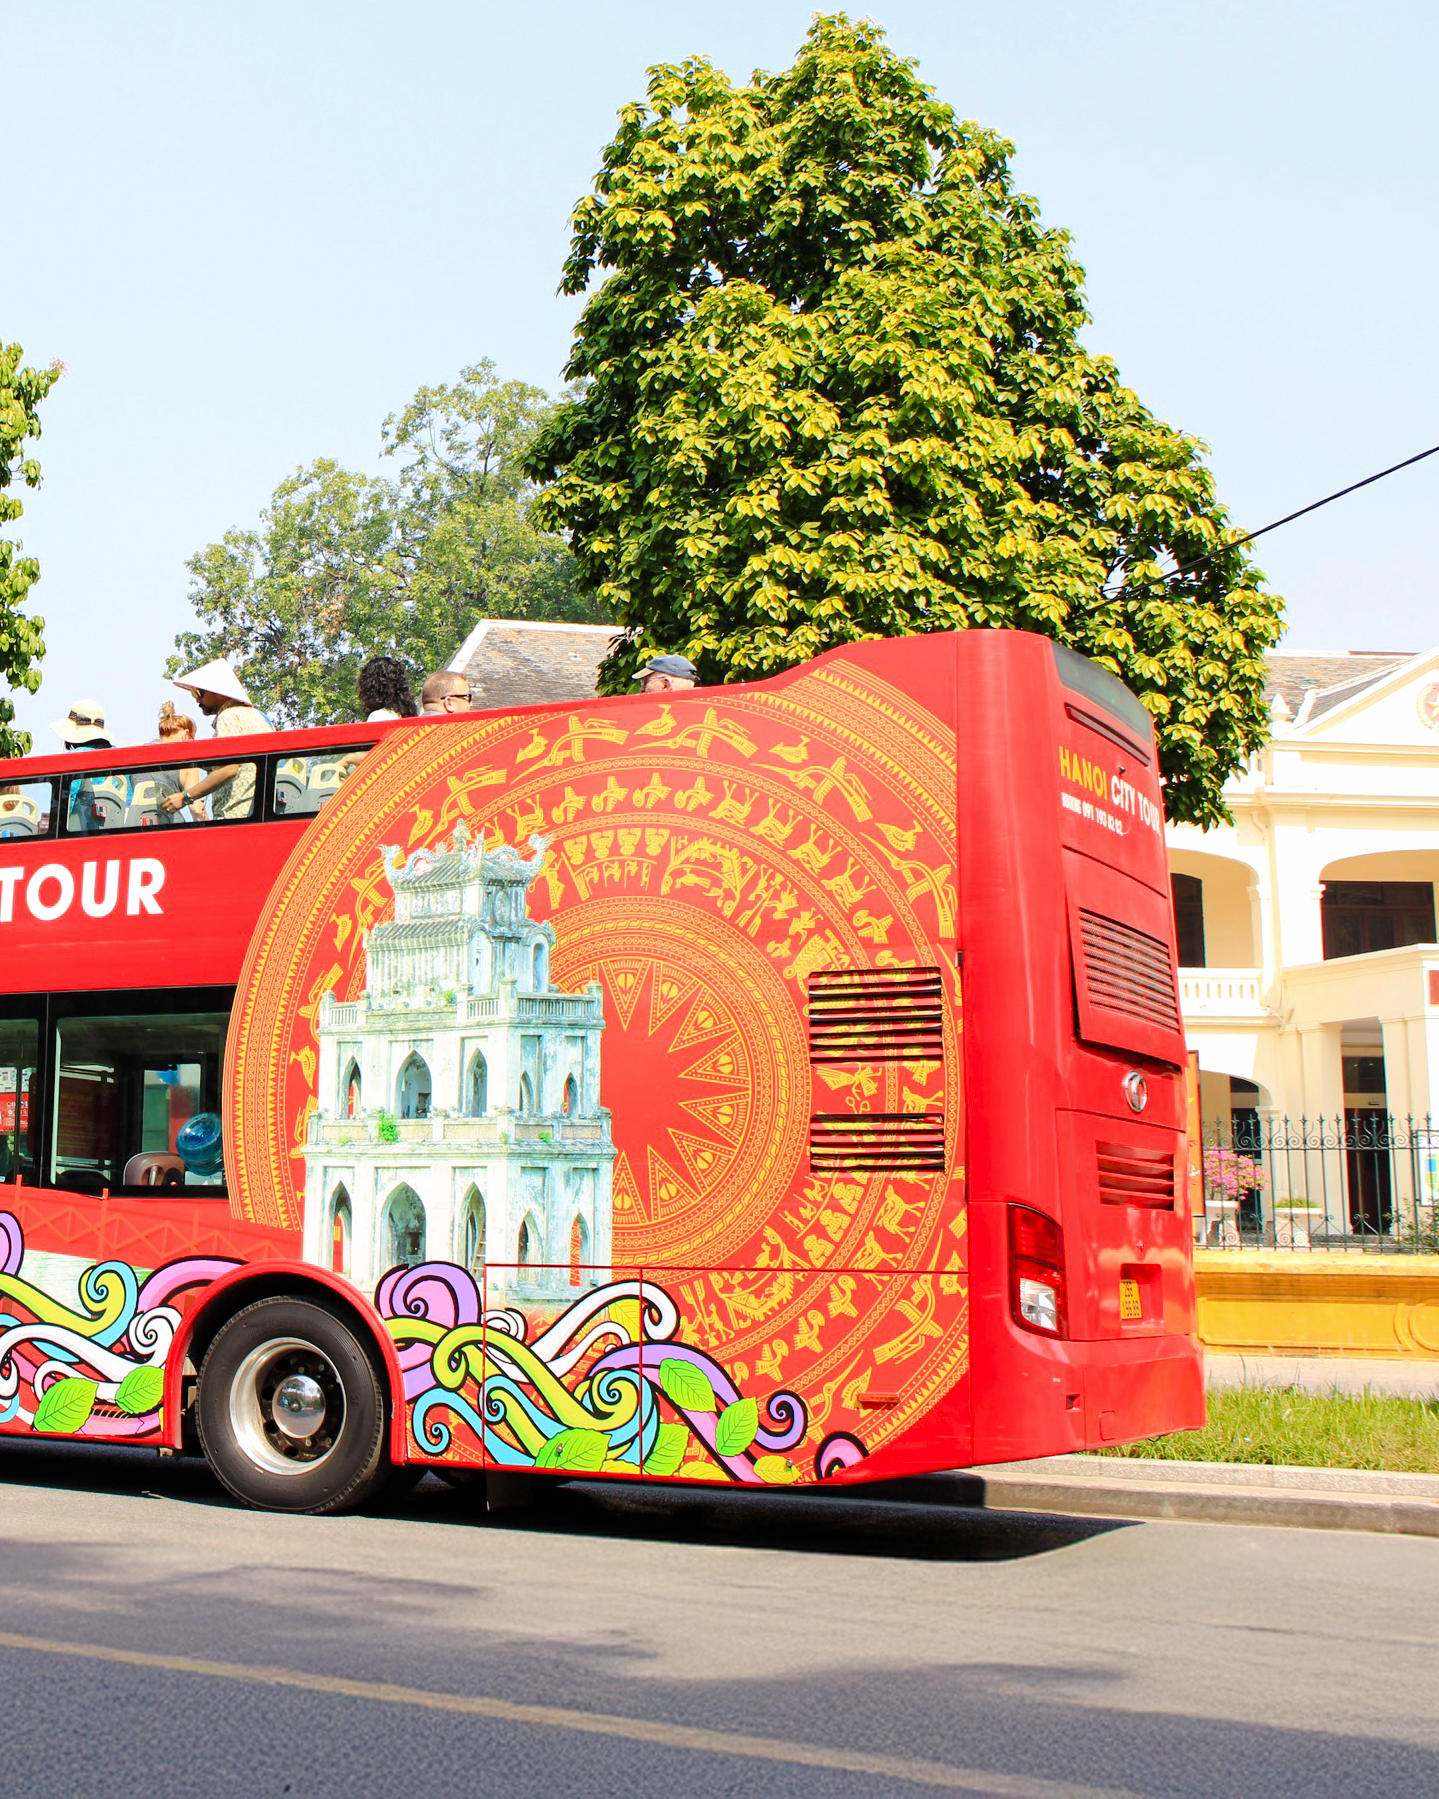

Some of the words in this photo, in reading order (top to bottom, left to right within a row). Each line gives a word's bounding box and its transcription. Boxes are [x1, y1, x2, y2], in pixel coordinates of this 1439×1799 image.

[1059, 745, 1108, 801] HANOI
[1111, 775, 1136, 816] CITY
[1137, 791, 1162, 837] TOUR
